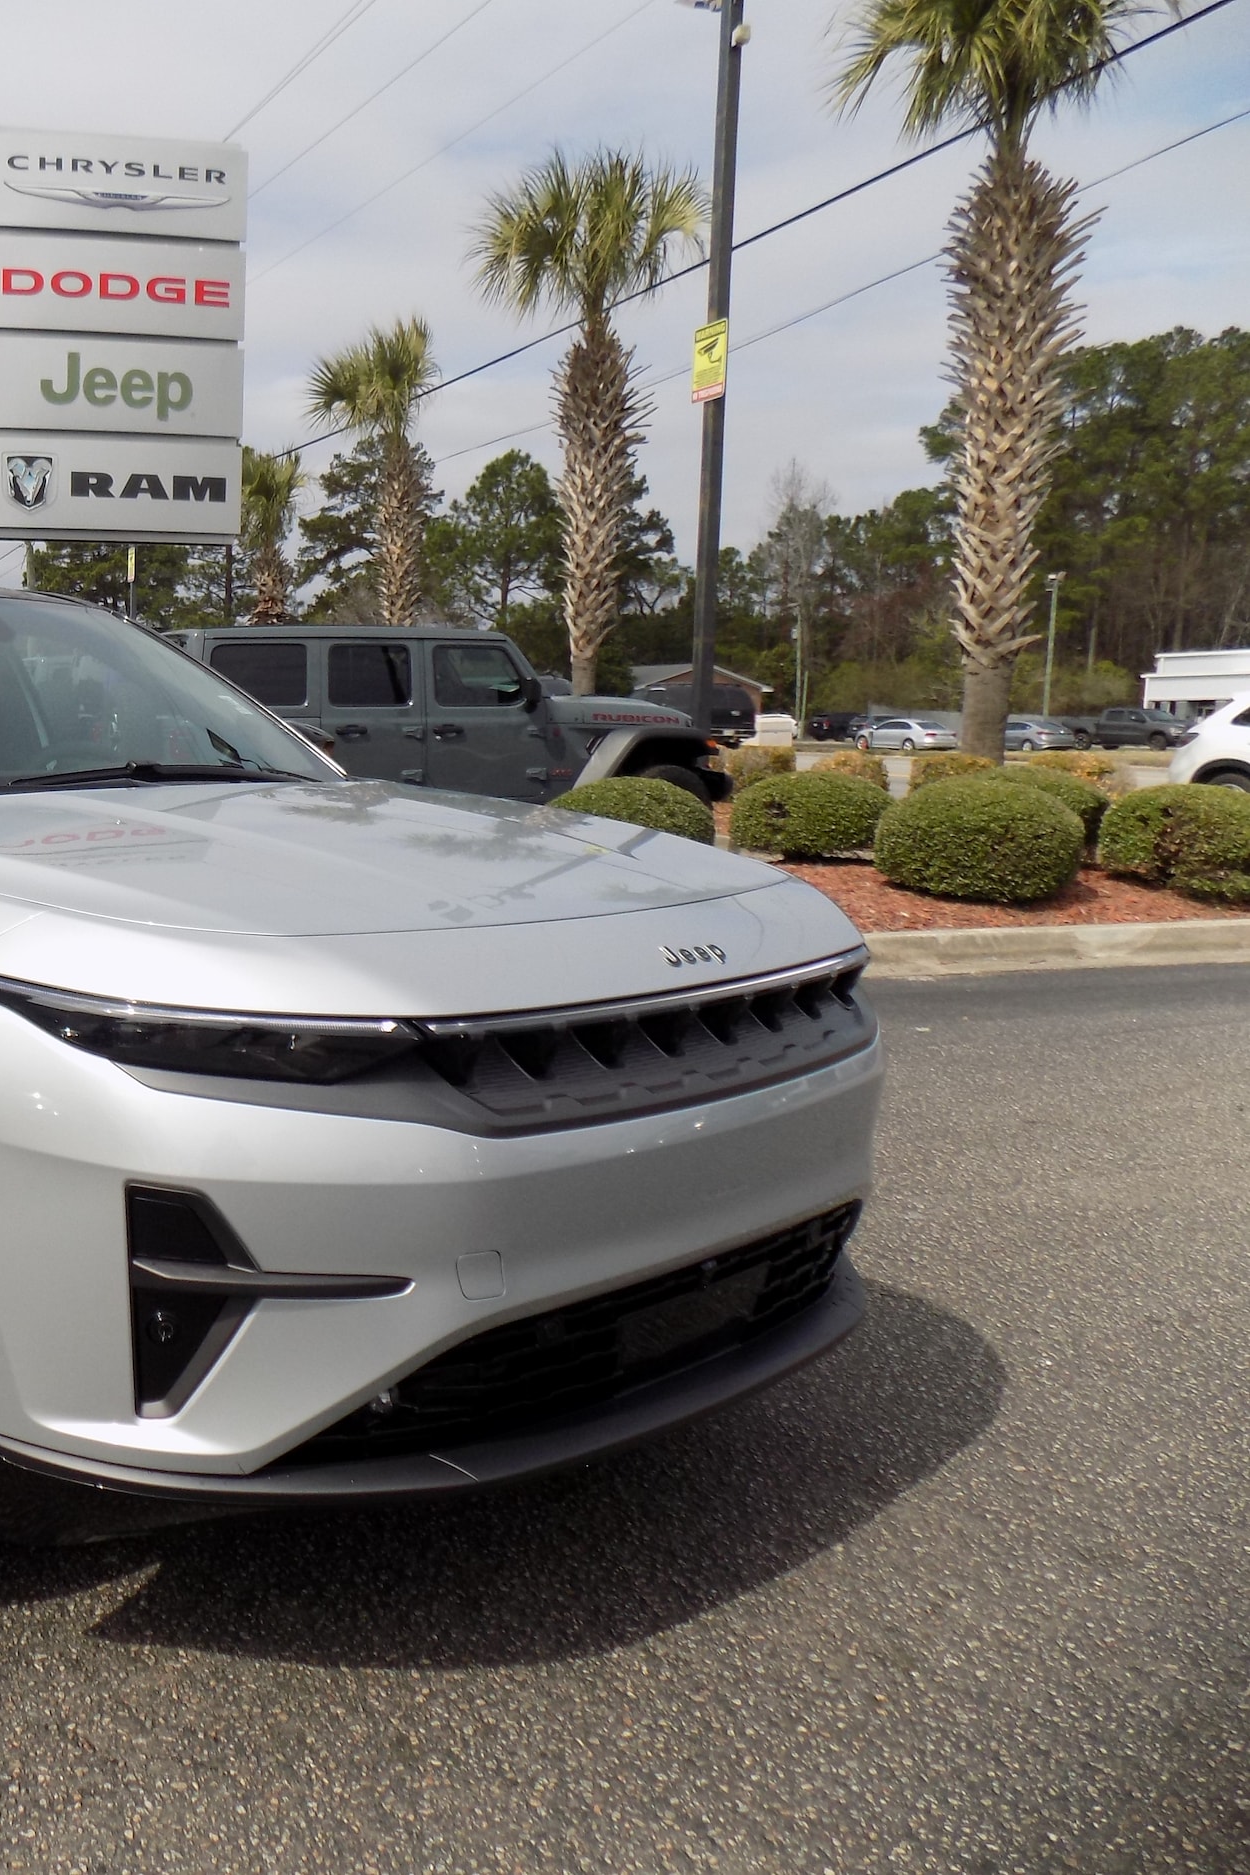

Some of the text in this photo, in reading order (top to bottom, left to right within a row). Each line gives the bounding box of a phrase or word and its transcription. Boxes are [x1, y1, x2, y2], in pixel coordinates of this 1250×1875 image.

[7, 155, 227, 185] CHRYSLER
[2, 268, 230, 309] DODGE
[40, 352, 193, 421] Jeep
[70, 471, 227, 503] RAM
[592, 713, 680, 725] RUBICON
[658, 944, 726, 968] Jeep
